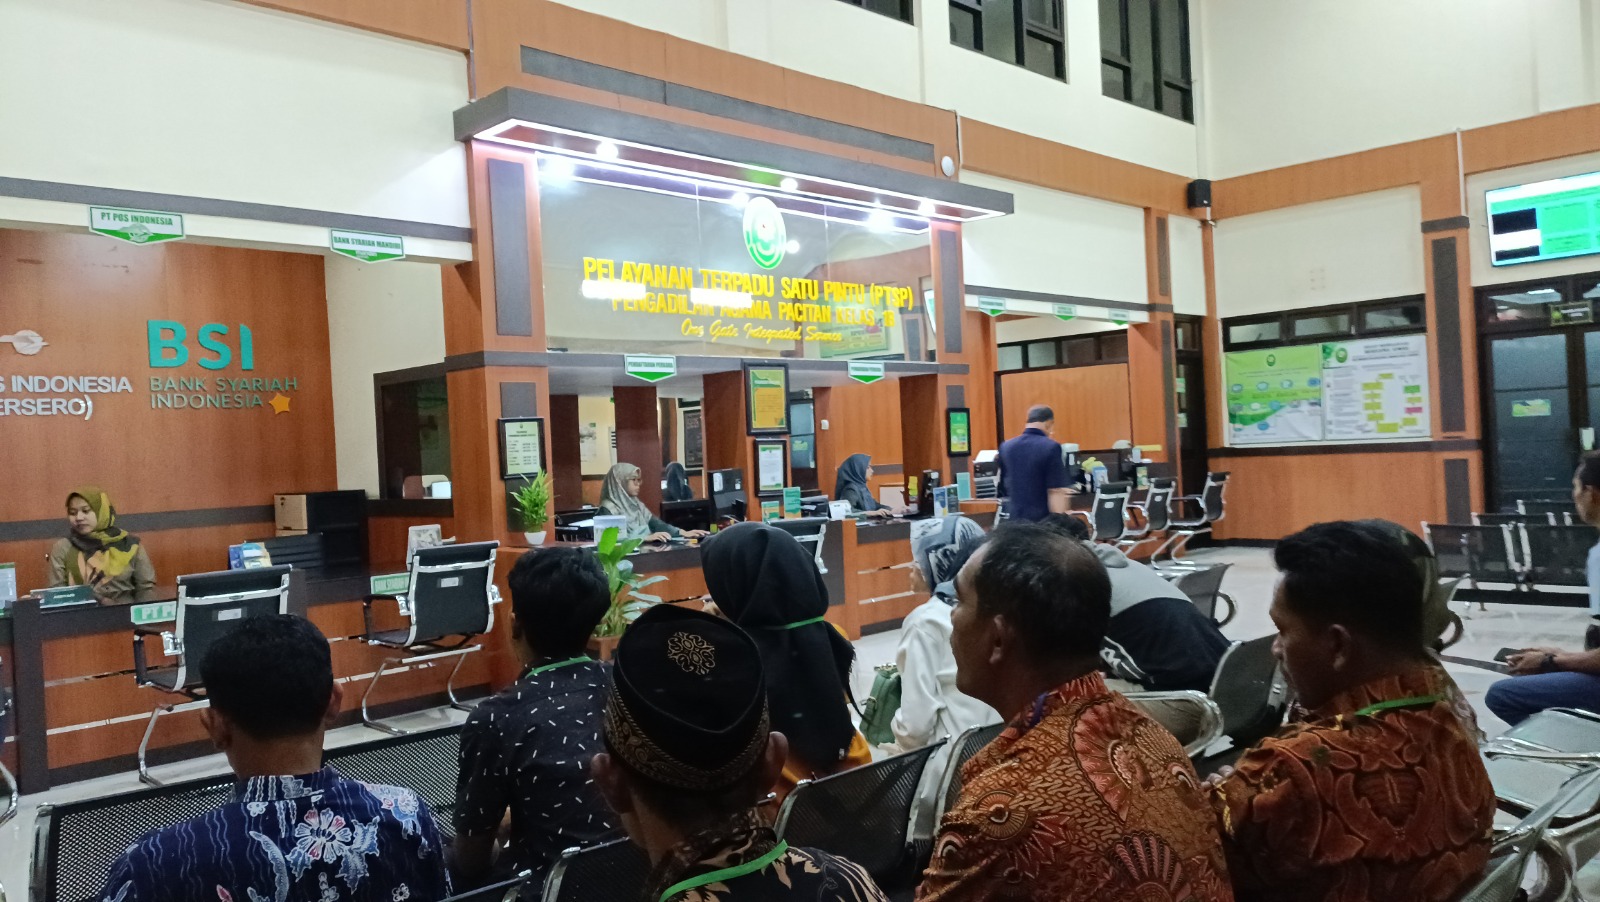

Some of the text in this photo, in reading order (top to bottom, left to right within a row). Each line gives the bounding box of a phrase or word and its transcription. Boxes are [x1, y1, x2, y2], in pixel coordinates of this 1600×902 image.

[101, 212, 173, 226] PT POS INDONESIA
[583, 256, 914, 310] PELAYANAN TERPADU SATU PINTU (PTSP)
[778, 302, 831, 322] PACITAN
[836, 307, 875, 326] KELAS
[709, 320, 739, 343] Gate
[147, 320, 254, 370] BSI
[11, 375, 133, 393] INDONESIA
[150, 376, 298, 392] BANK SYARIAH
[150, 393, 263, 409] INDONESIA
[141, 606, 158, 620] PT
